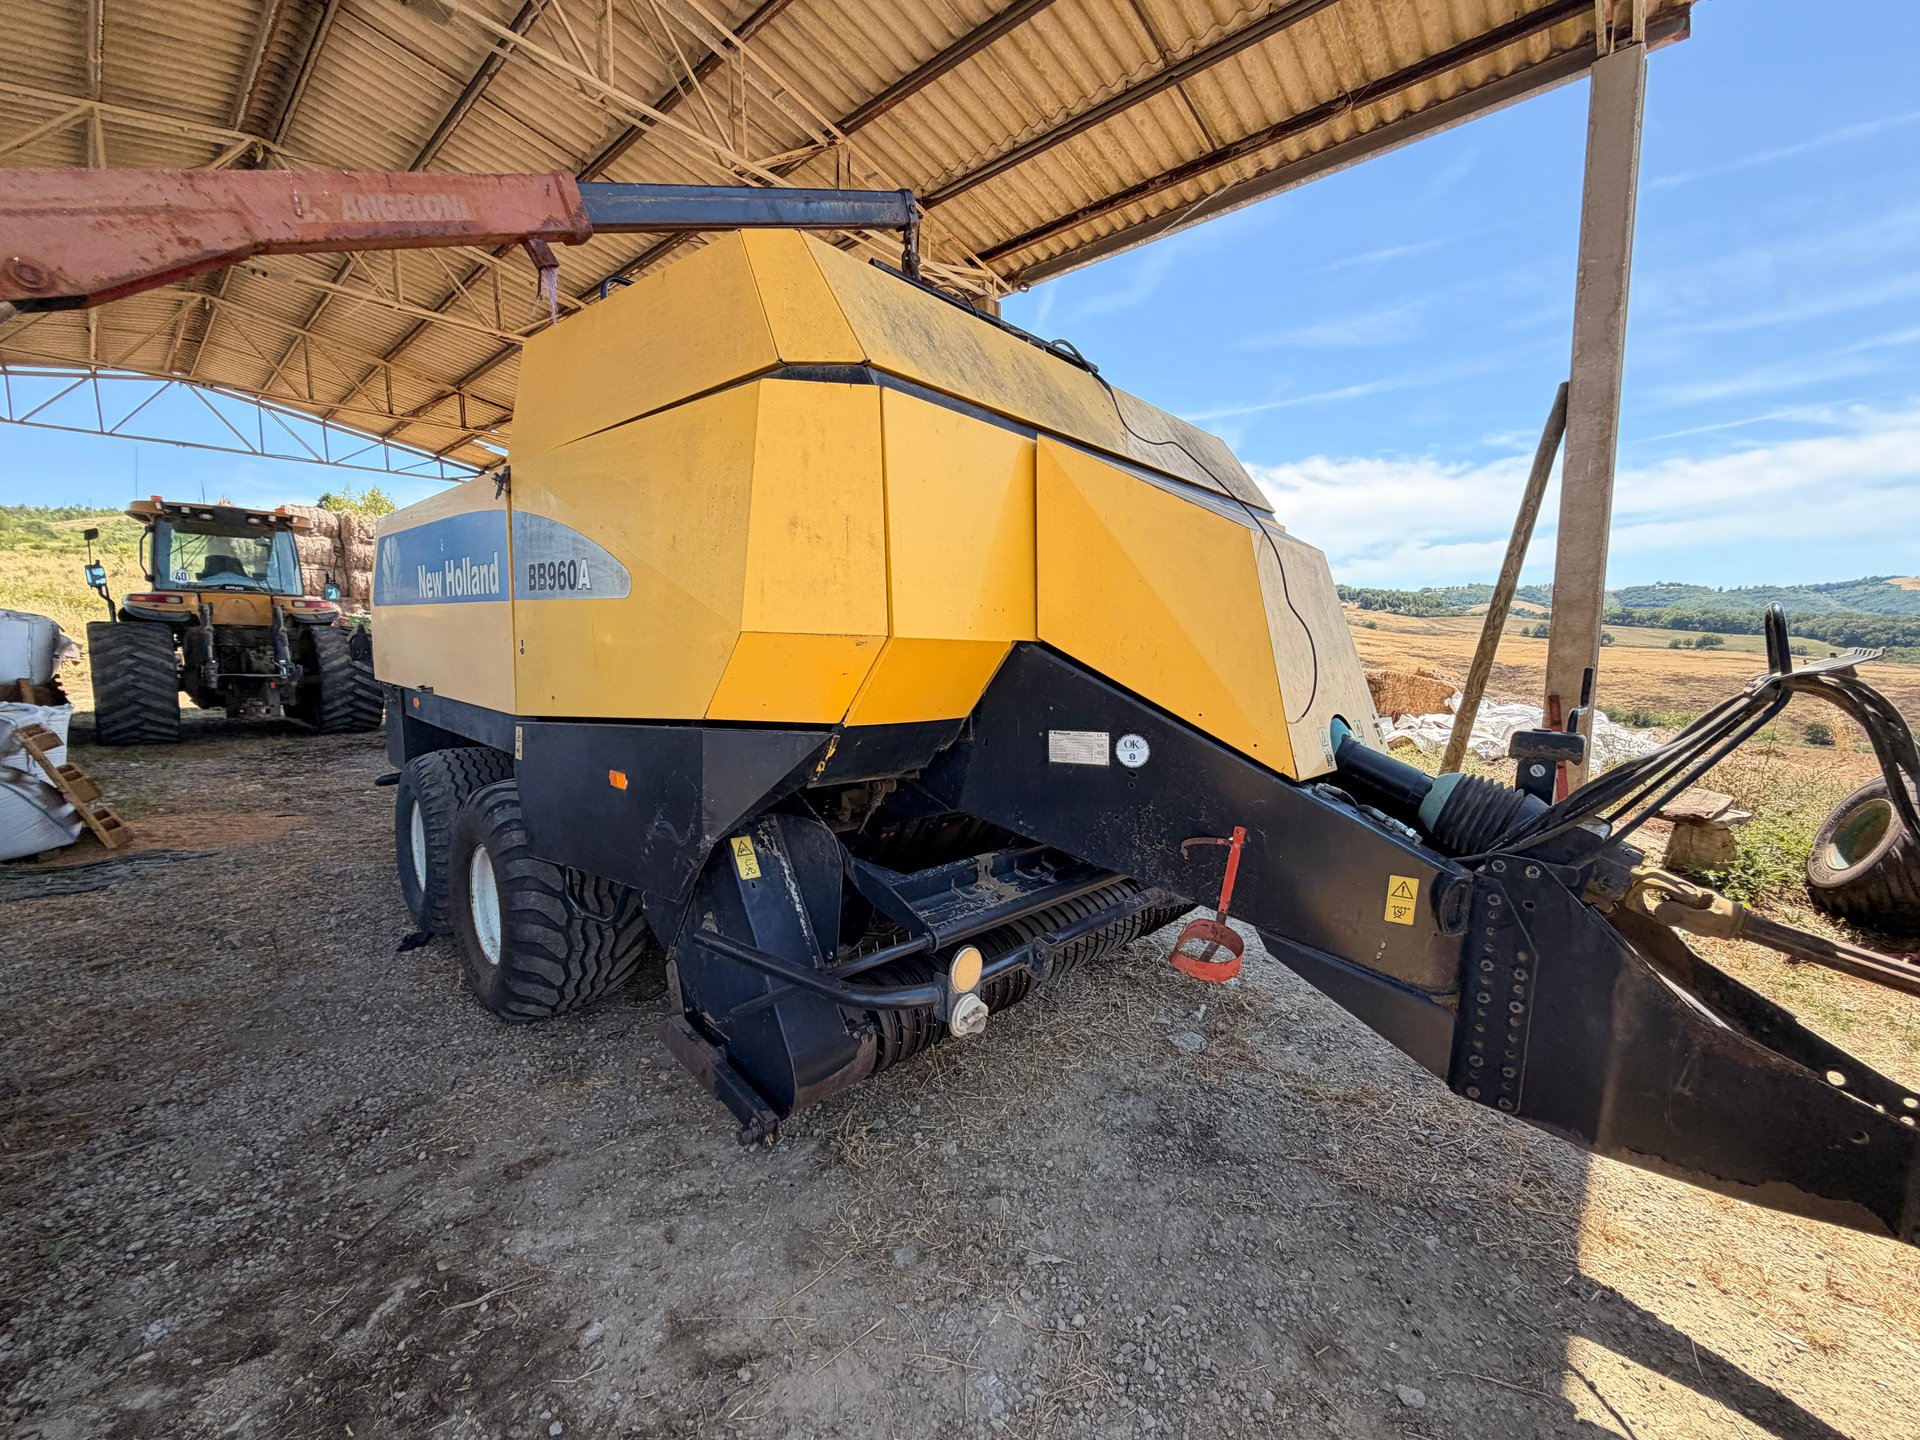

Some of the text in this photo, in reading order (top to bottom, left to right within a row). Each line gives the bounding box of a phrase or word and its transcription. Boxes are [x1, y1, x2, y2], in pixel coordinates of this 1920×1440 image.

[174, 571, 188, 581] 40
[418, 551, 500, 599] New Holland
[528, 558, 592, 591] BB960A
[1123, 739, 1140, 749] OK
